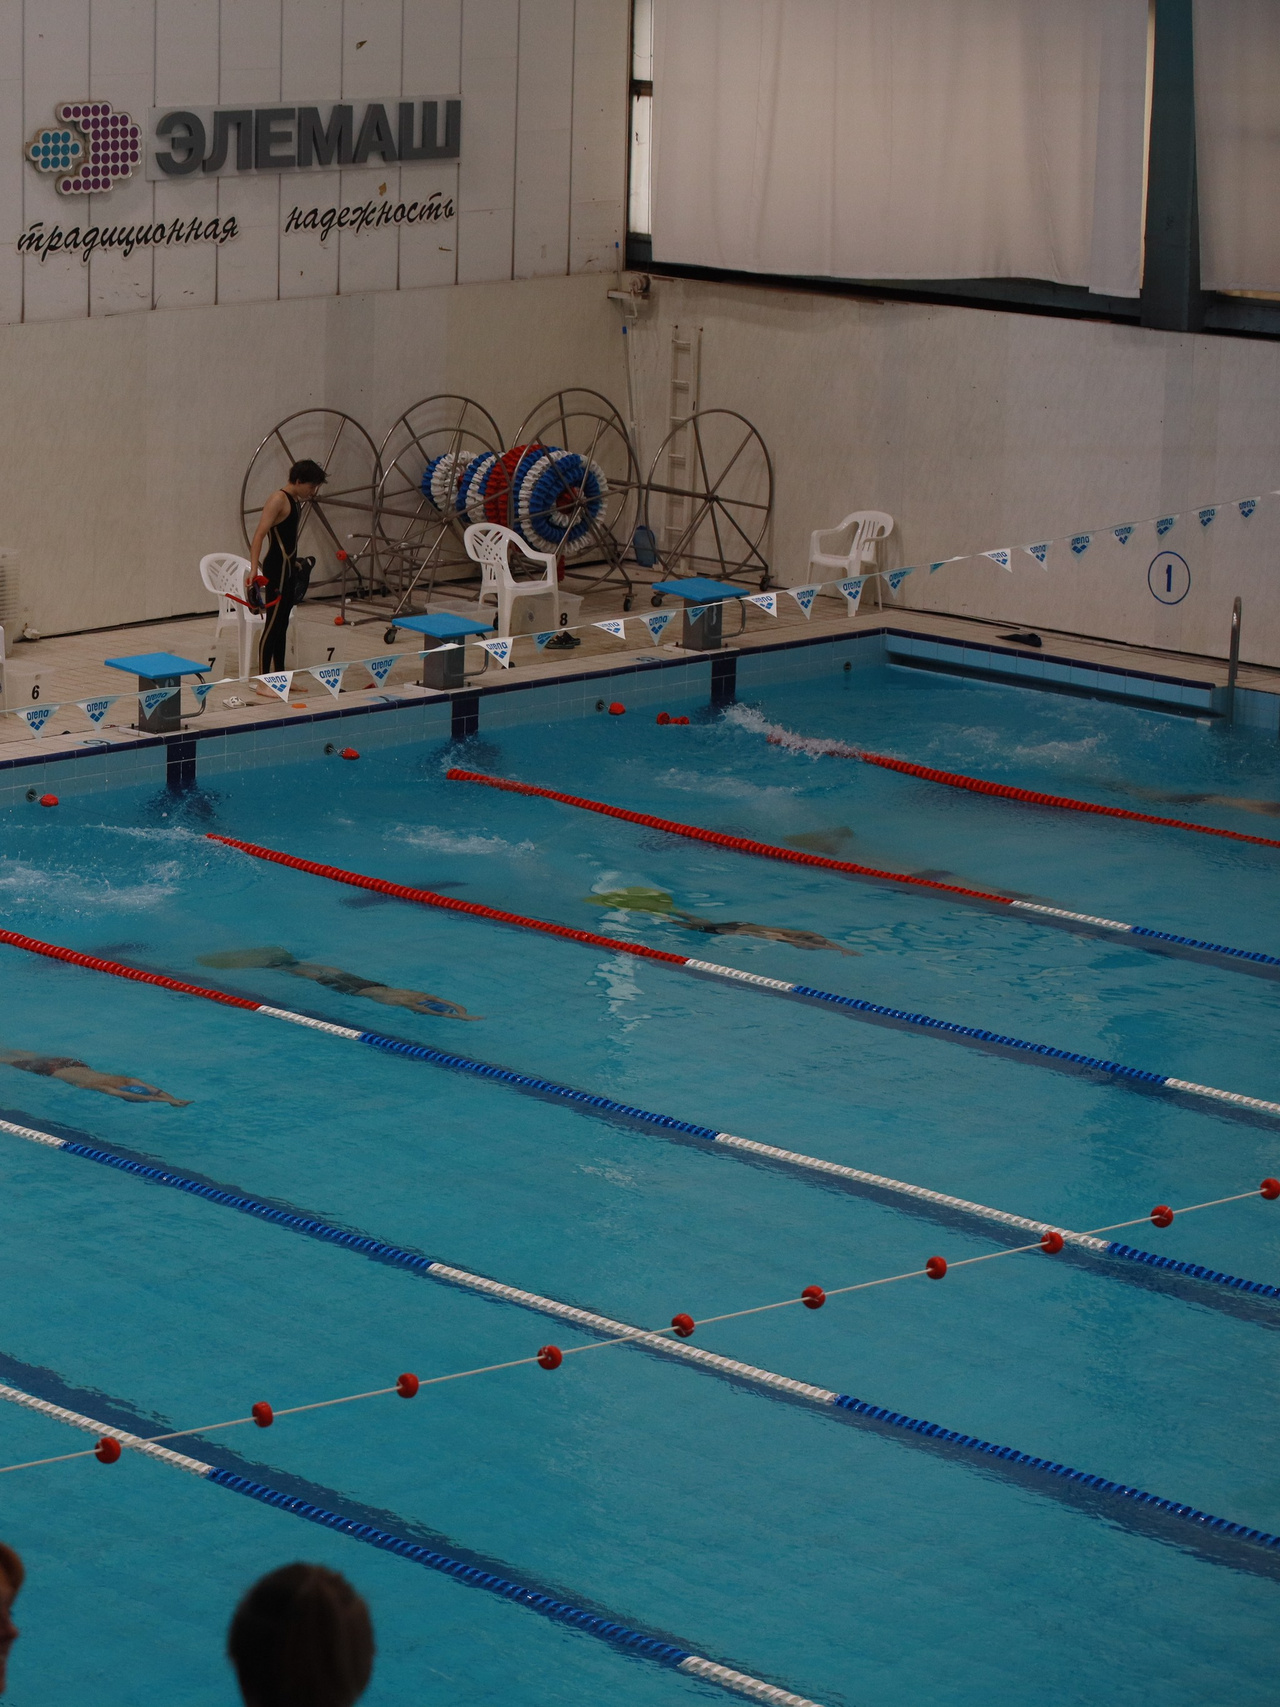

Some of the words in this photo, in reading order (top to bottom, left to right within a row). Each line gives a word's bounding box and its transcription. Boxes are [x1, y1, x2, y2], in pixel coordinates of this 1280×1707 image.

[155, 100, 462, 175] ЭЛЕМАШ
[18, 215, 239, 264] традиционная
[285, 192, 455, 242] надежность
[842, 580, 862, 591] arena
[559, 612, 568, 626] 8
[326, 647, 336, 661] 7
[208, 657, 217, 669] 7
[371, 659, 393, 671] arena
[319, 668, 341, 679] arena
[31, 684, 40, 700] 6
[86, 700, 108, 713] arena
[26, 709, 50, 721] arena
